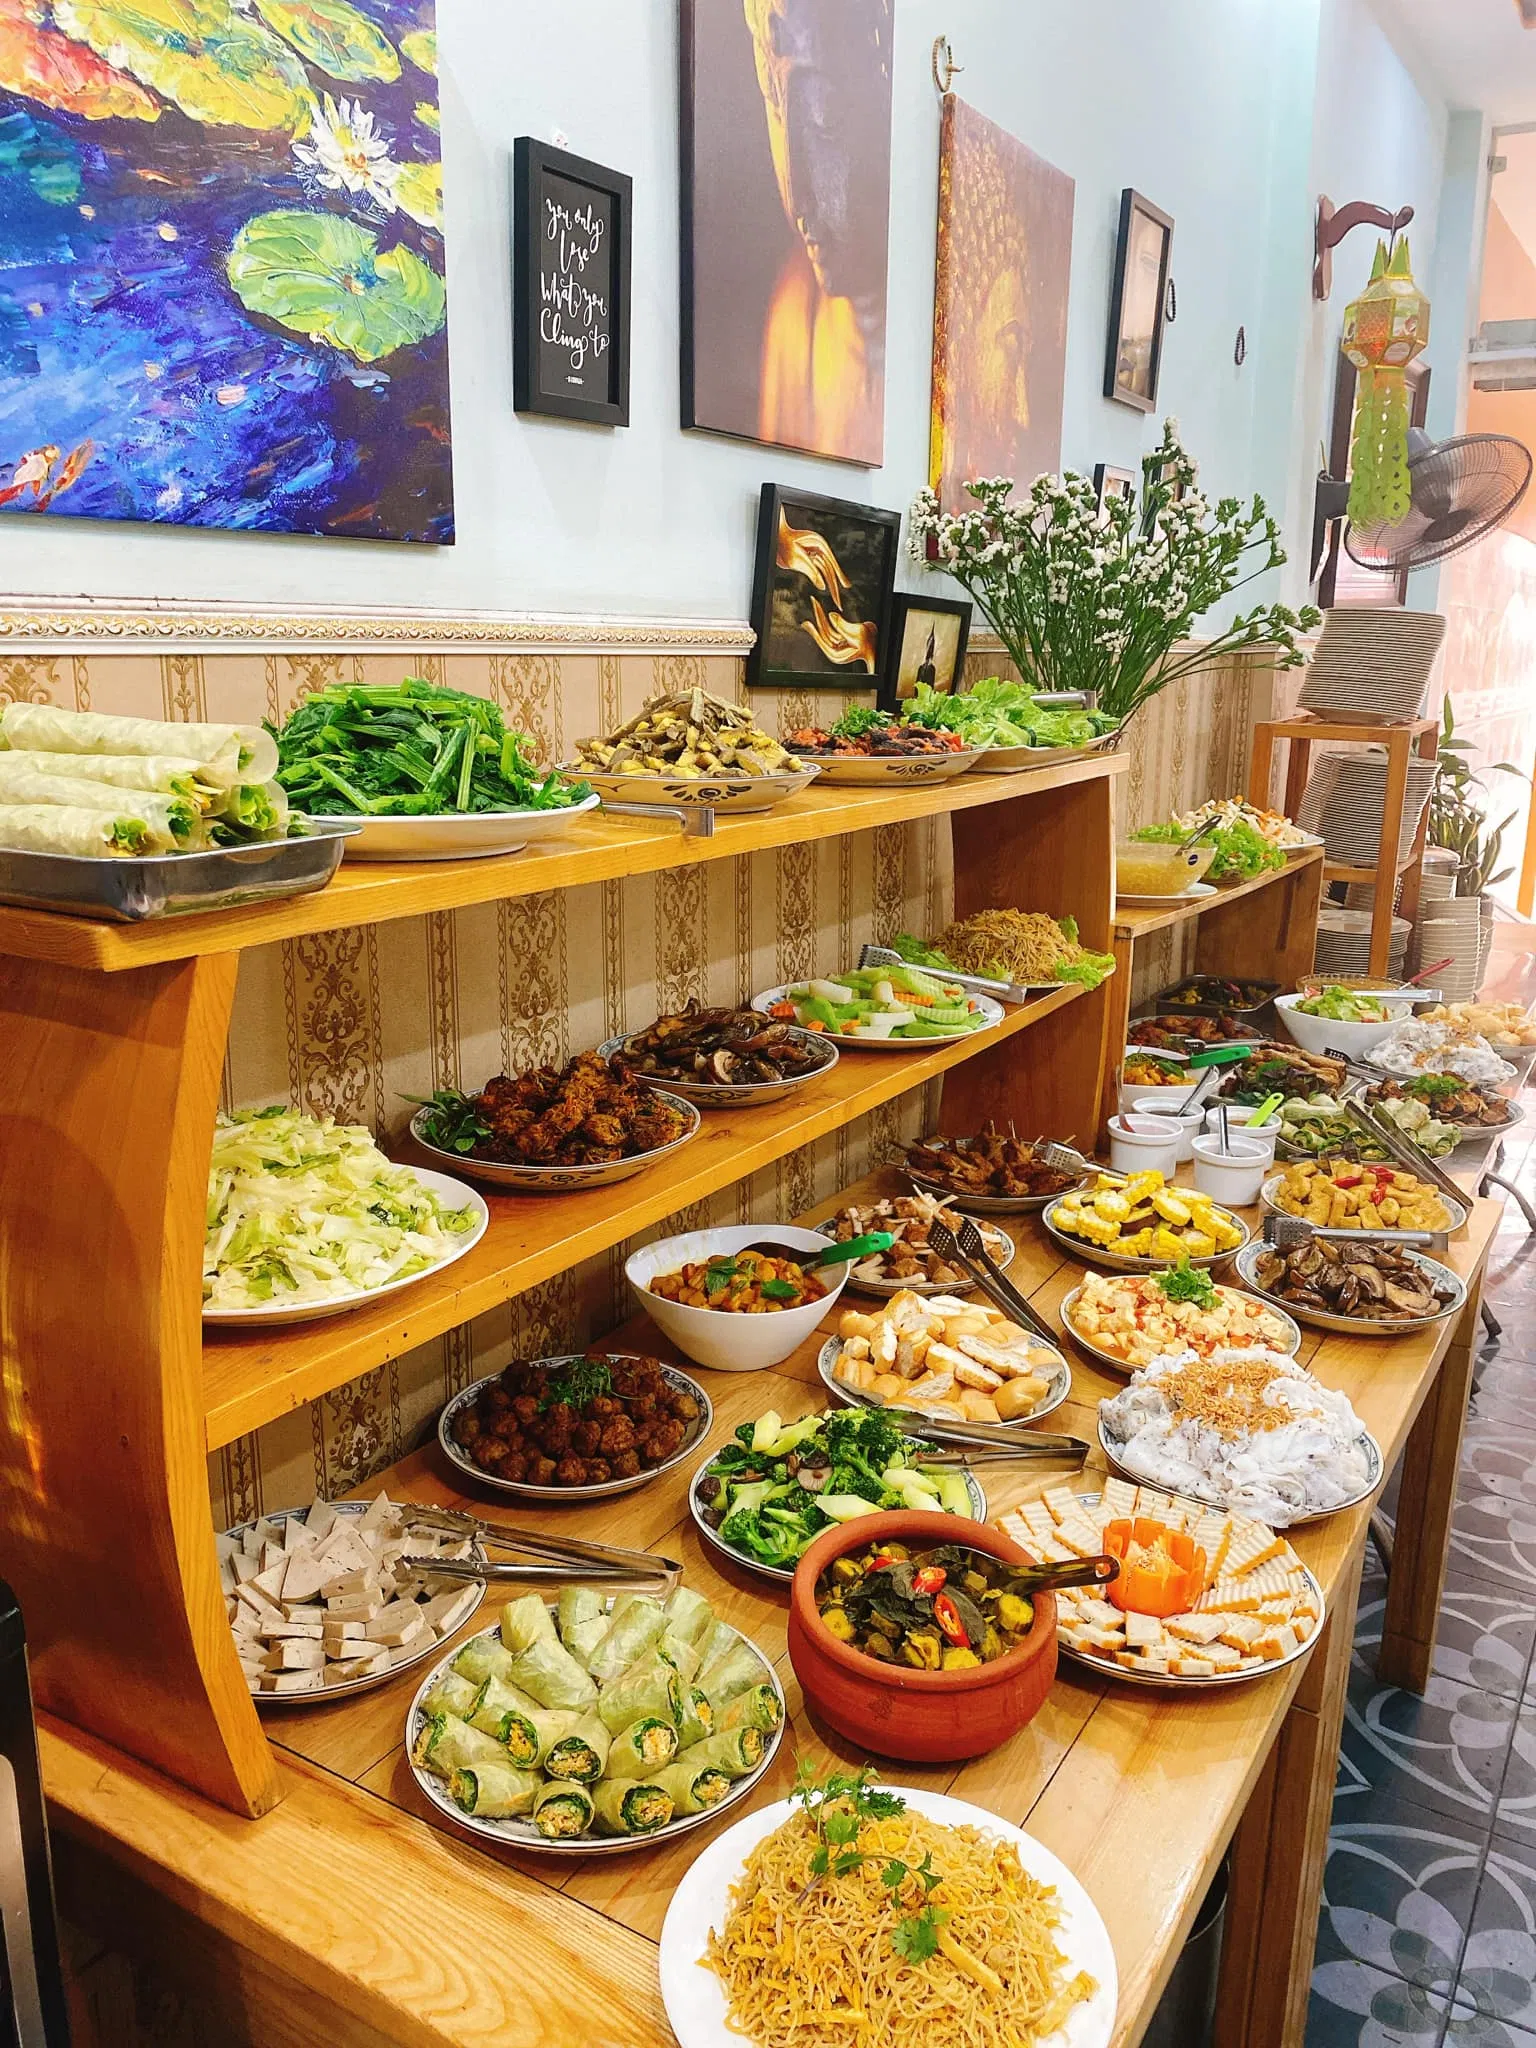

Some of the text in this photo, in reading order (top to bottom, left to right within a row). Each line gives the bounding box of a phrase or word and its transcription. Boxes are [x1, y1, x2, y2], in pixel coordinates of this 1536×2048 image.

[574, 204, 604, 254] only
[541, 308, 610, 370] Cling to
